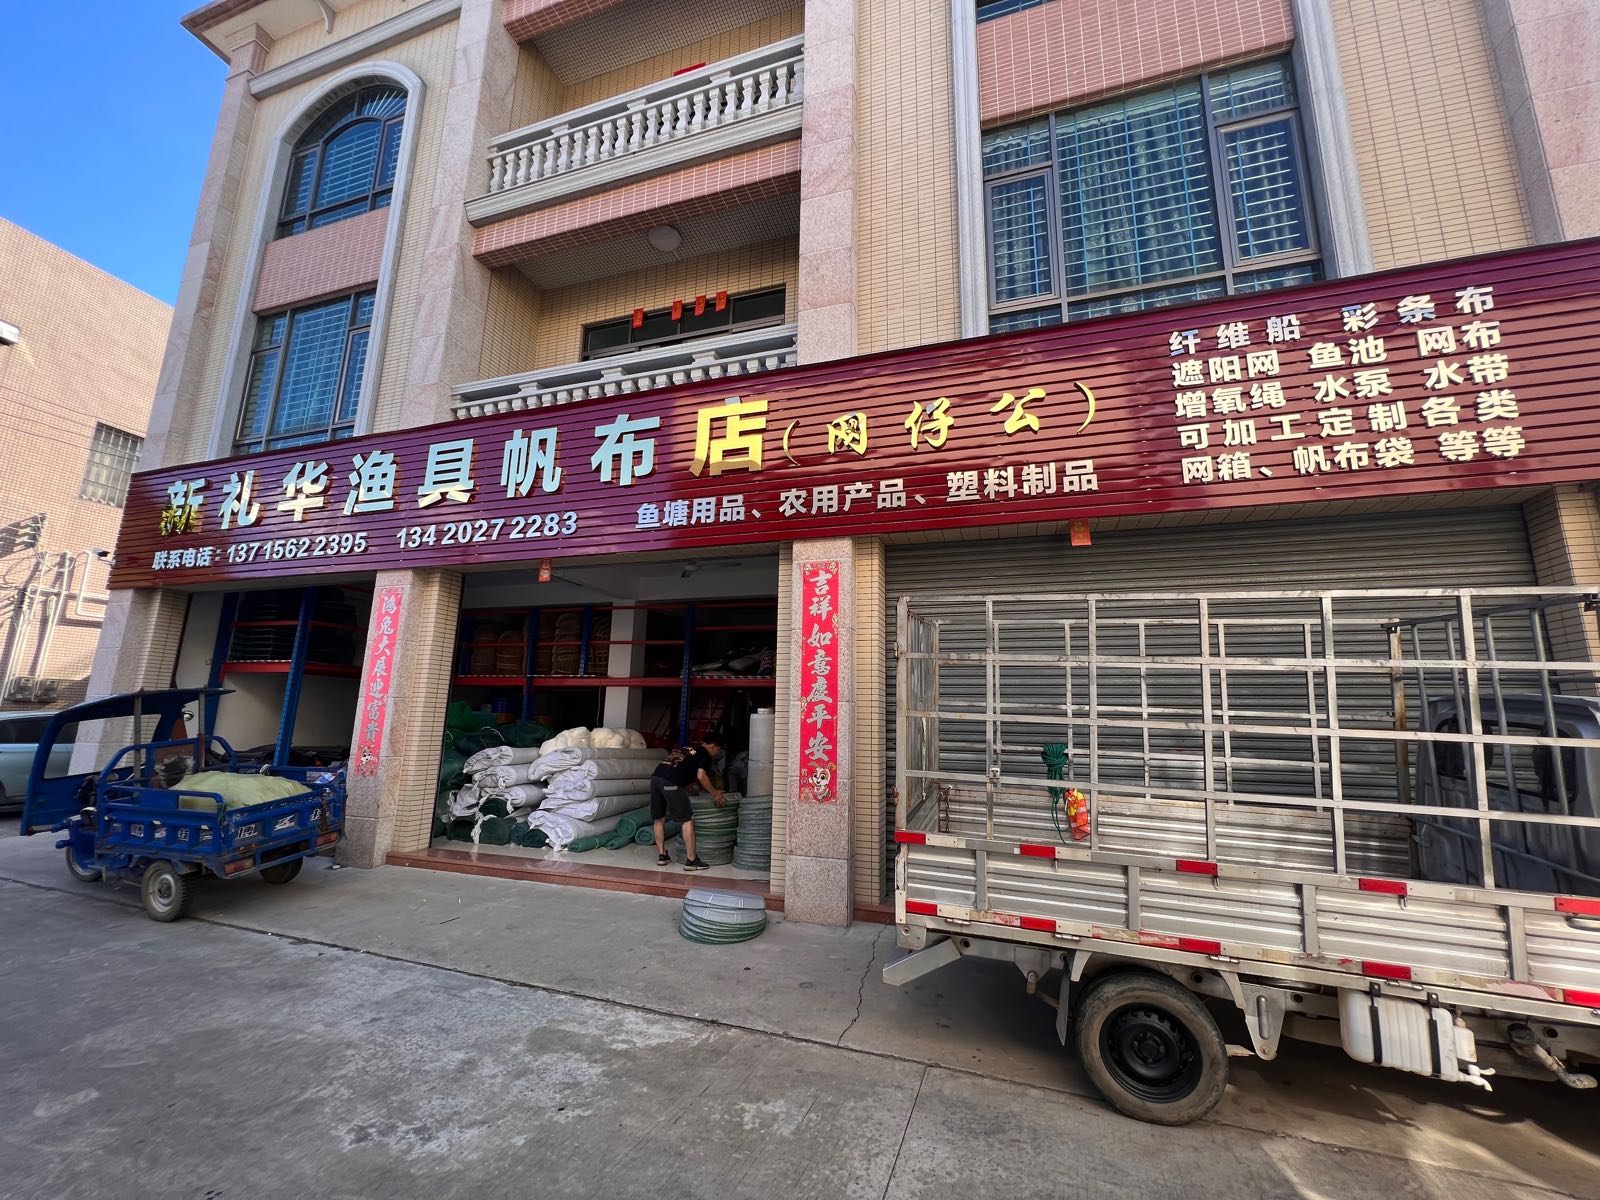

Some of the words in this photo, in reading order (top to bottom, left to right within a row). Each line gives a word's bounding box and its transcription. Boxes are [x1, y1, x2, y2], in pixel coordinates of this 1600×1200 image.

[1169, 315, 1301, 357] 纤维船
[1341, 285, 1495, 334] 彩条布
[1172, 350, 1281, 388] 遮阳网
[1308, 337, 1388, 370] 鱼池
[1418, 320, 1502, 357] 网布
[1175, 381, 1287, 420] 增氧绳
[1314, 368, 1395, 404] 水泵
[1424, 353, 1510, 390] 水带
[1177, 388, 1520, 451] 可加工定制各类
[1181, 436, 1416, 484] 网箱、帆布袋
[1438, 425, 1527, 462] 等等
